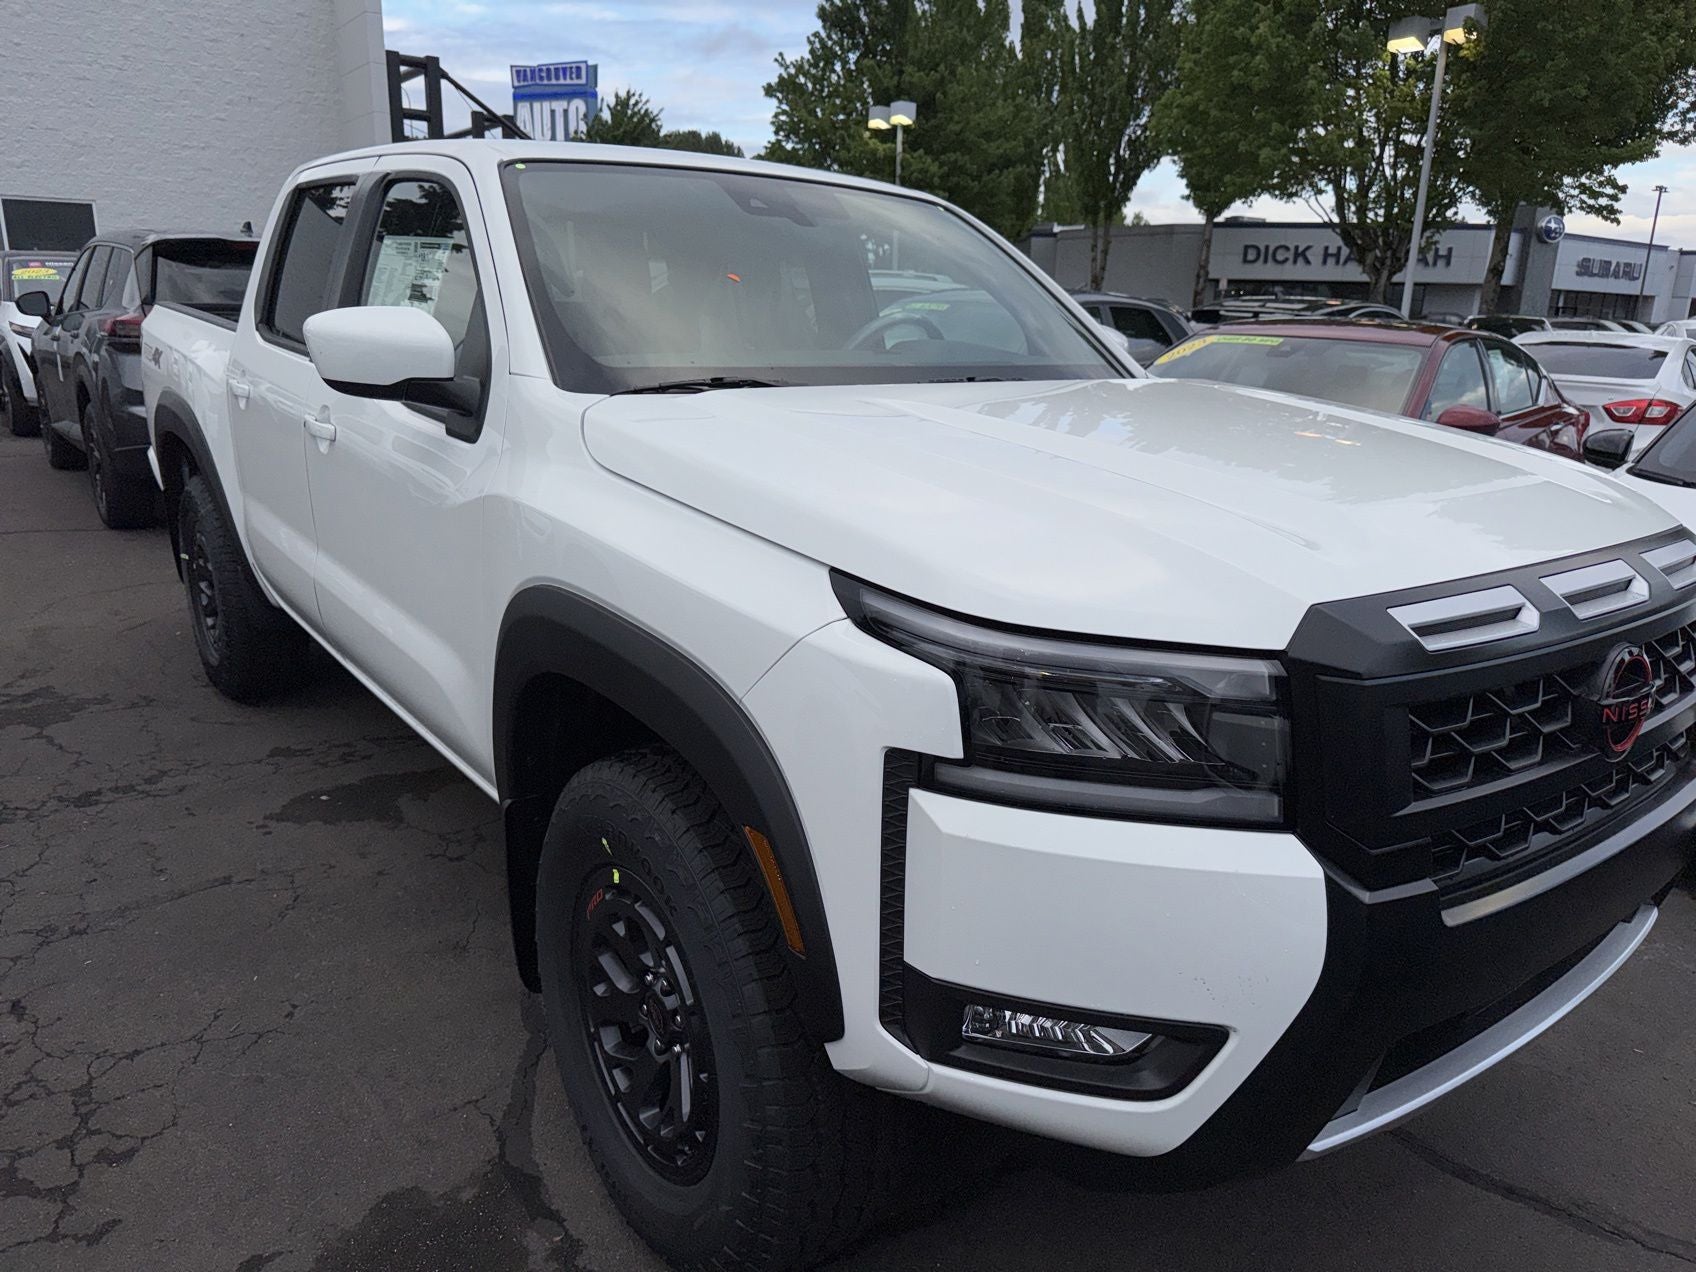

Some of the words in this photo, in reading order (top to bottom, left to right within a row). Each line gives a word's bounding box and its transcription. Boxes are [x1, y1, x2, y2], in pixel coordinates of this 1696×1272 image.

[515, 65, 582, 83] VANCOUVER
[516, 98, 587, 141] AUTO
[1242, 244, 1313, 266] DICK
[1321, 245, 1454, 268] HAAH
[1576, 257, 1643, 281] SUBARU
[1602, 699, 1650, 723] NISS
